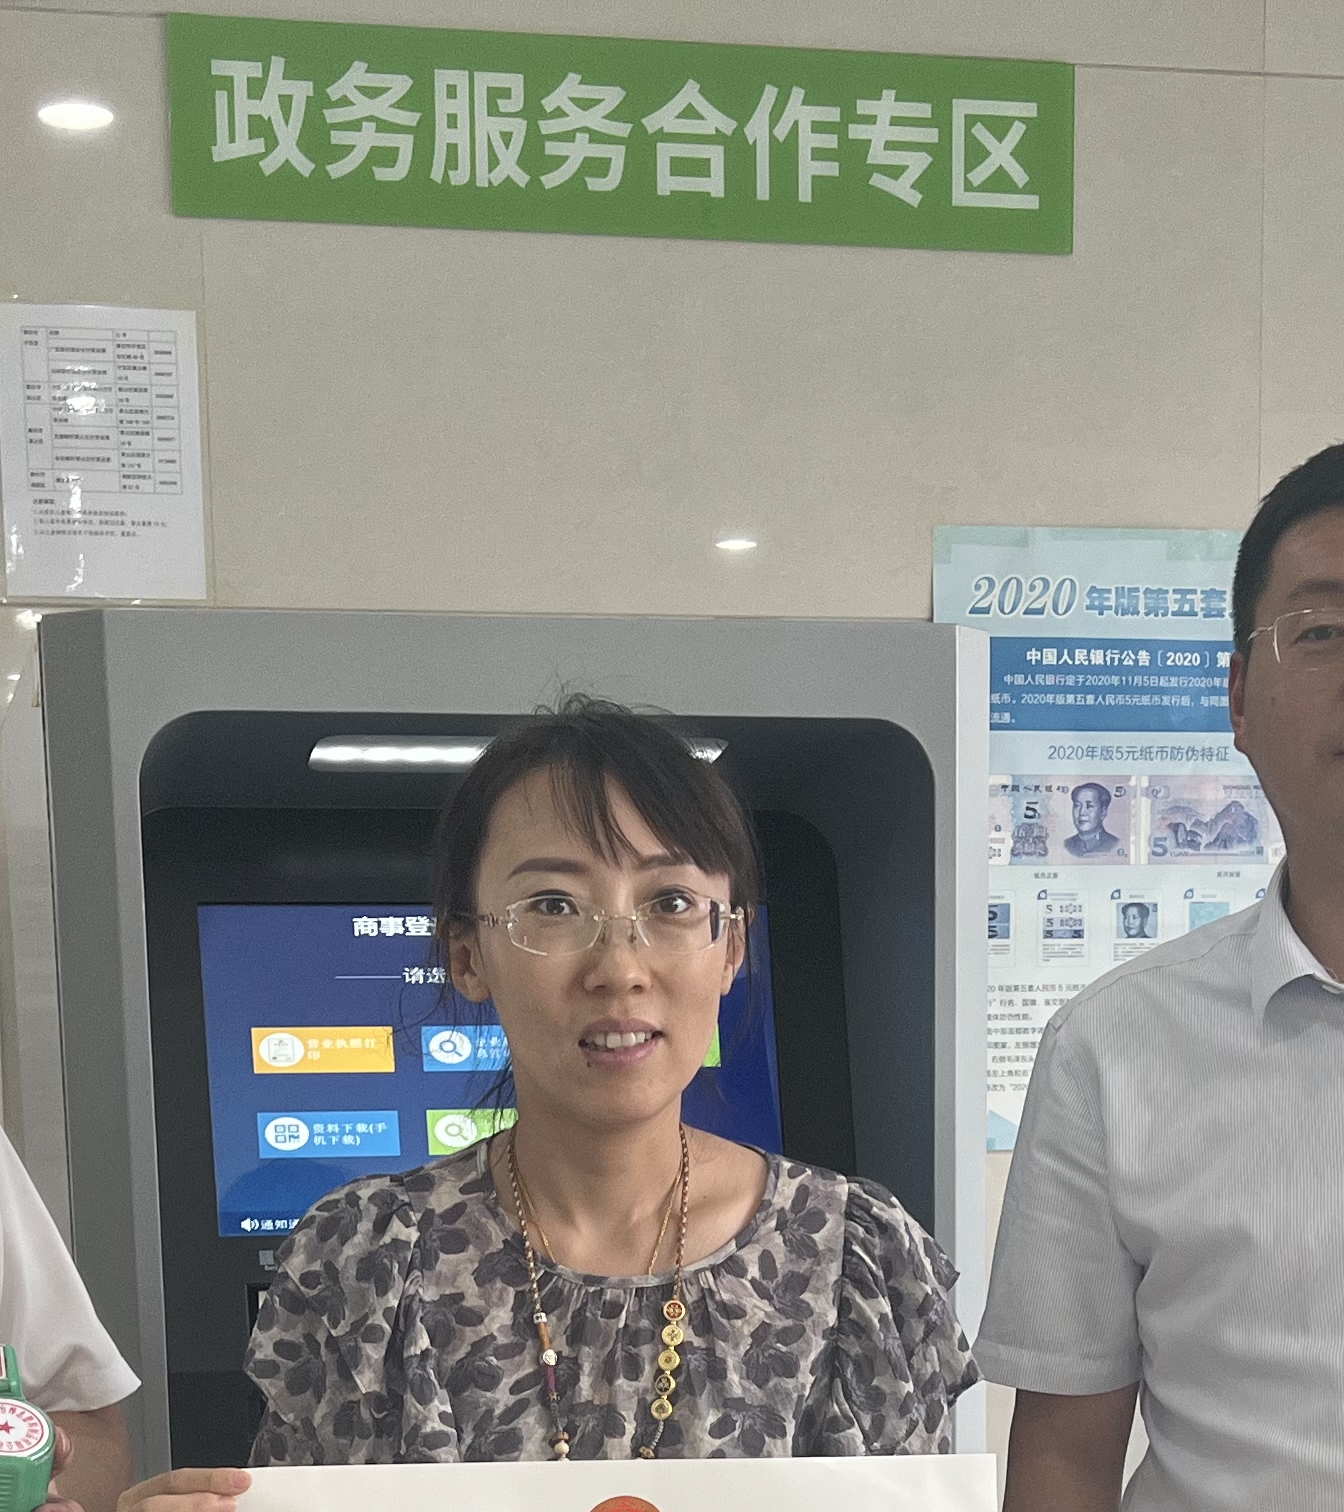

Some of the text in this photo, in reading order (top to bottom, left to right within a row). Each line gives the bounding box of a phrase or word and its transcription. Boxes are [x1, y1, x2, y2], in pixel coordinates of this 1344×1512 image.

[210, 55, 1040, 209] 政务服务合作专区
[968, 576, 1233, 619] 2020年版第五套
[1048, 745, 1229, 762] 2020年版5元纸币防伪特征
[1152, 837, 1169, 857] 5
